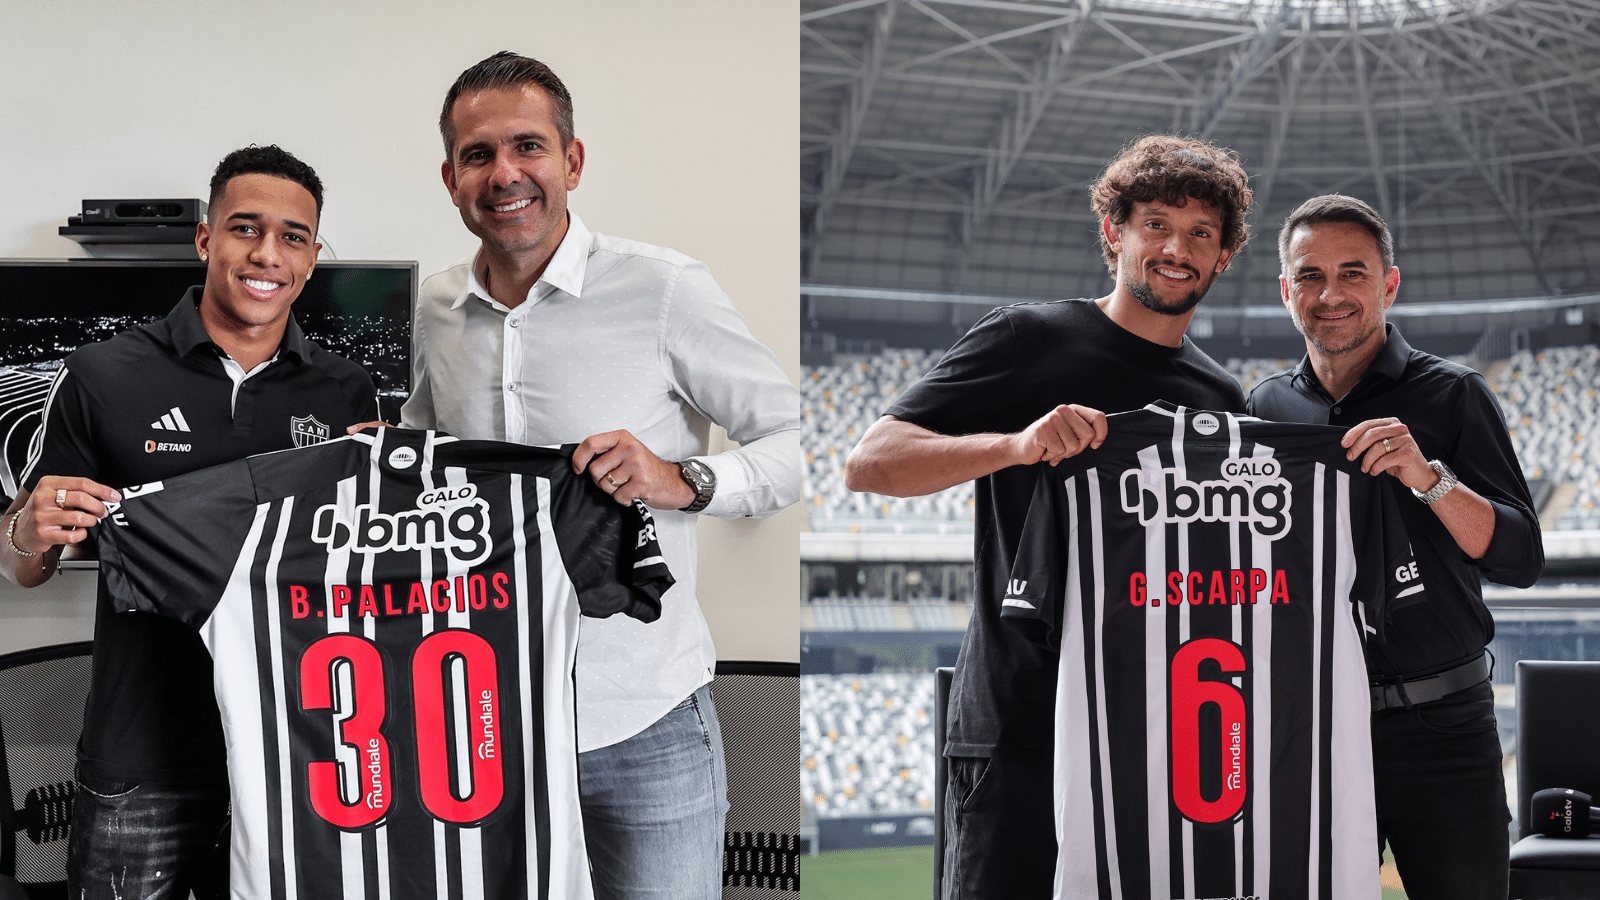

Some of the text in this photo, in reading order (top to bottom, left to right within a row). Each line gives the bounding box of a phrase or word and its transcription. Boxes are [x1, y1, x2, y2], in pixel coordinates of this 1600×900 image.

[157, 442, 192, 453] BETANO
[297, 423, 325, 437] CAM
[421, 486, 472, 505] GALO
[1225, 462, 1276, 477] GALO
[356, 502, 487, 561] bmg
[1164, 472, 1287, 536] bmg
[289, 571, 510, 620] B.PALACIOS
[1129, 568, 1290, 607] G.SCARPA
[299, 629, 505, 829] 30
[478, 689, 495, 760] mundiale
[1171, 637, 1247, 824] 6
[366, 738, 384, 810] mundiale
[1227, 722, 1241, 790] mundiale
